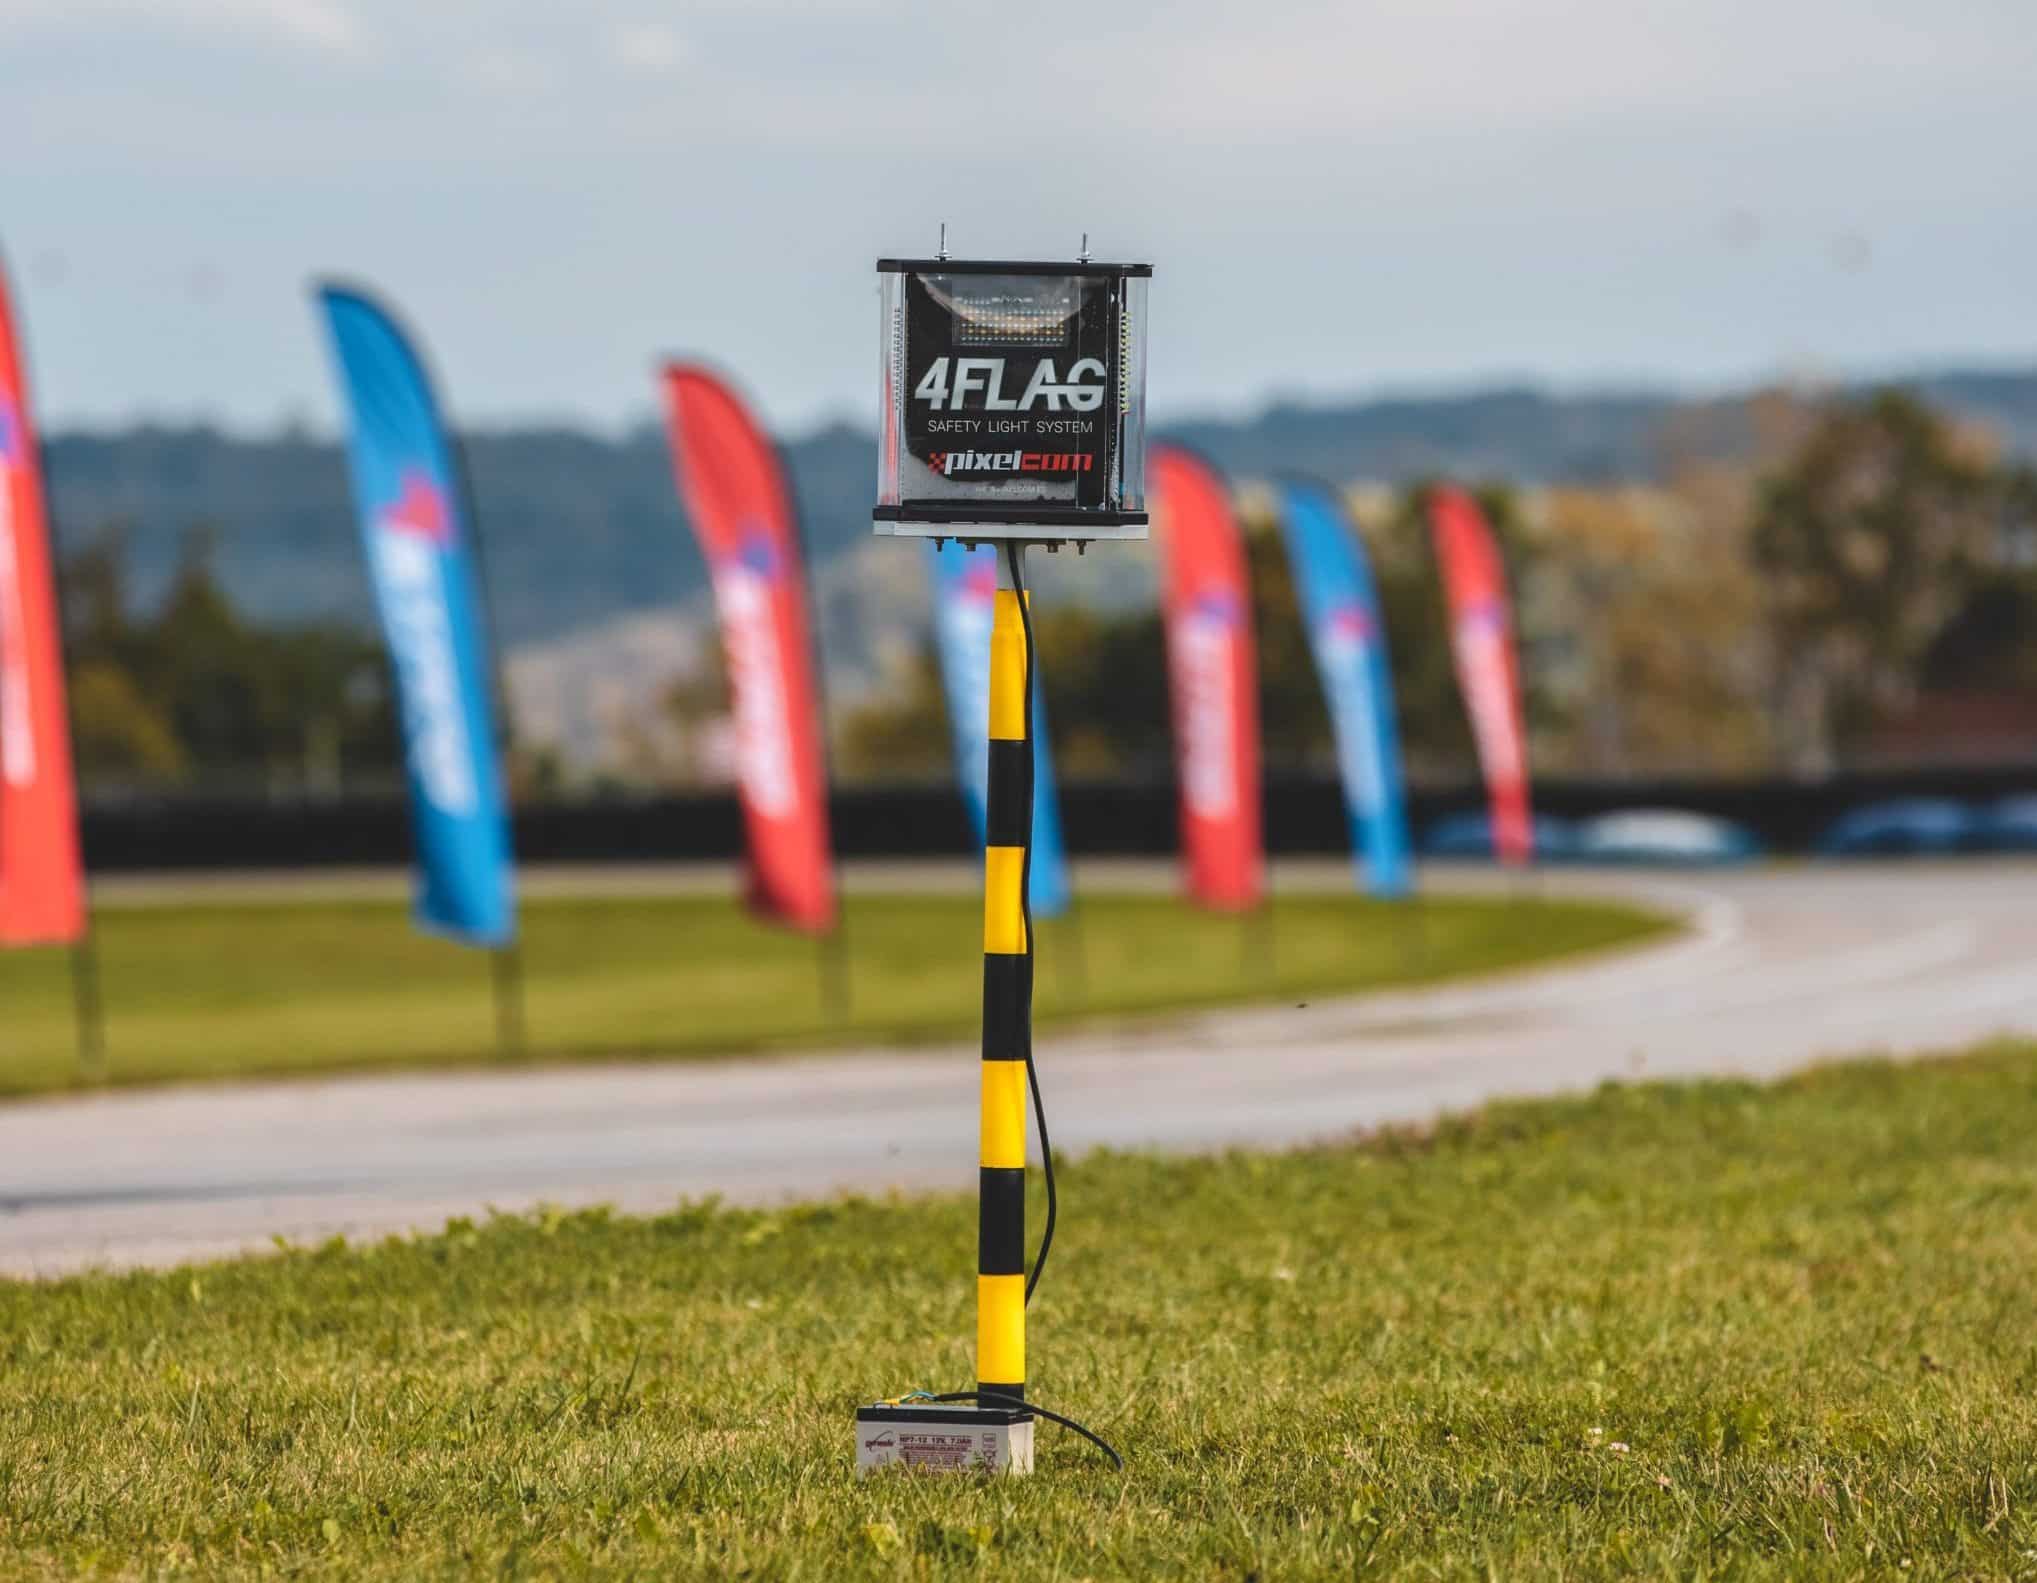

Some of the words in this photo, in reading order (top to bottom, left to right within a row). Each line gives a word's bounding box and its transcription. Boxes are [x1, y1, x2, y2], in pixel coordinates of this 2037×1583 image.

[914, 357, 1106, 412] 4FLAG
[928, 420, 981, 433] SAFETY
[988, 421, 1029, 433] LIGHT
[1036, 421, 1093, 433] SYSTEM
[944, 450, 1093, 475] pixelcom
